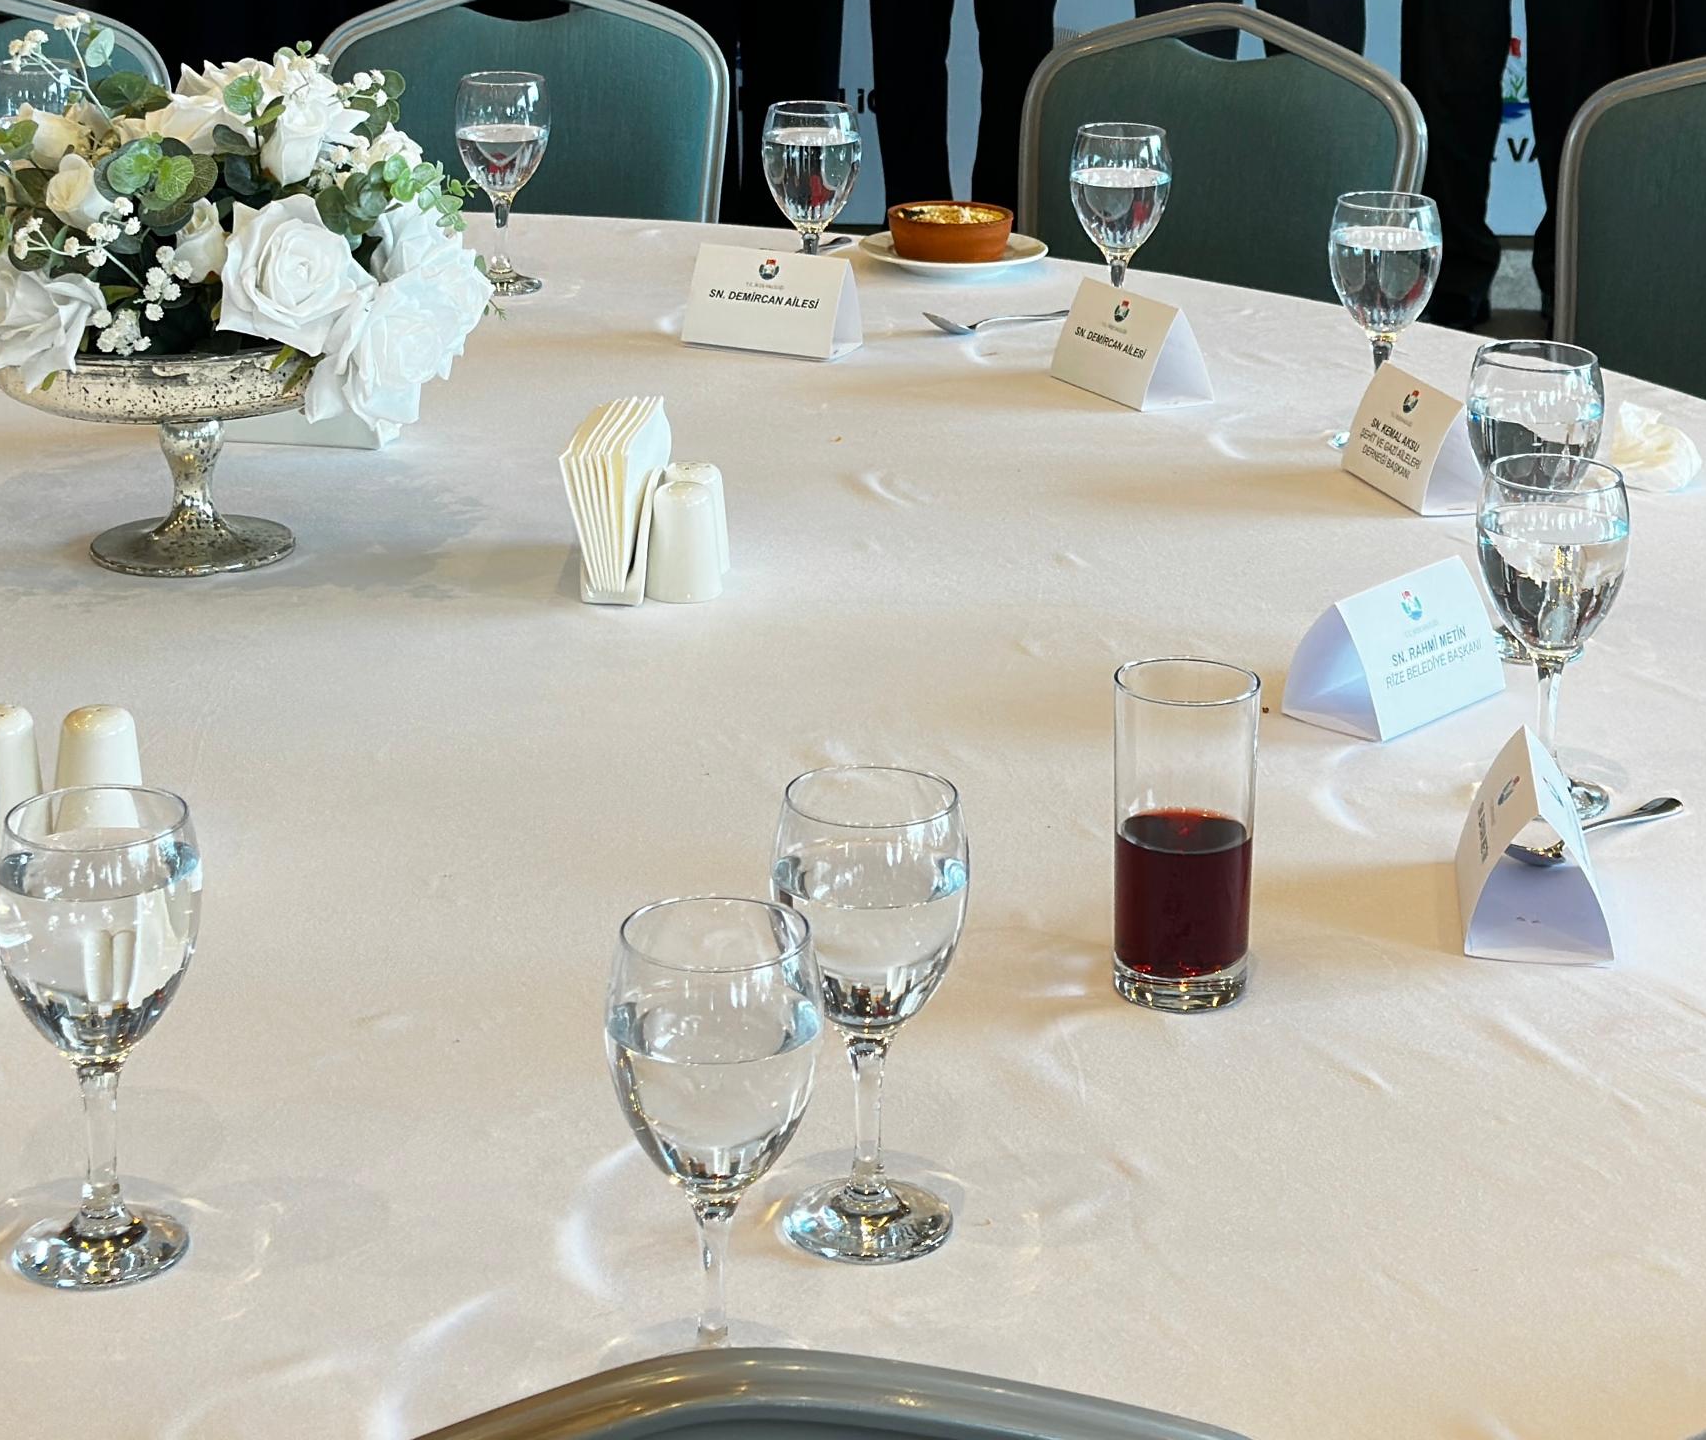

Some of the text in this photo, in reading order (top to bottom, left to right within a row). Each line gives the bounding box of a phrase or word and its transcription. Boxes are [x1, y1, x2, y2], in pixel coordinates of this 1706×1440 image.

[709, 288, 820, 309] SN. DEMİRCAN AİLESİ
[1074, 326, 1086, 338] SN.
[1086, 331, 1124, 353] DEMİRCAN
[1122, 343, 1147, 360] AİLESİ
[1391, 652, 1408, 667] SN.
[1408, 634, 1438, 662] RAHMİ
[1439, 625, 1466, 651] METİN
